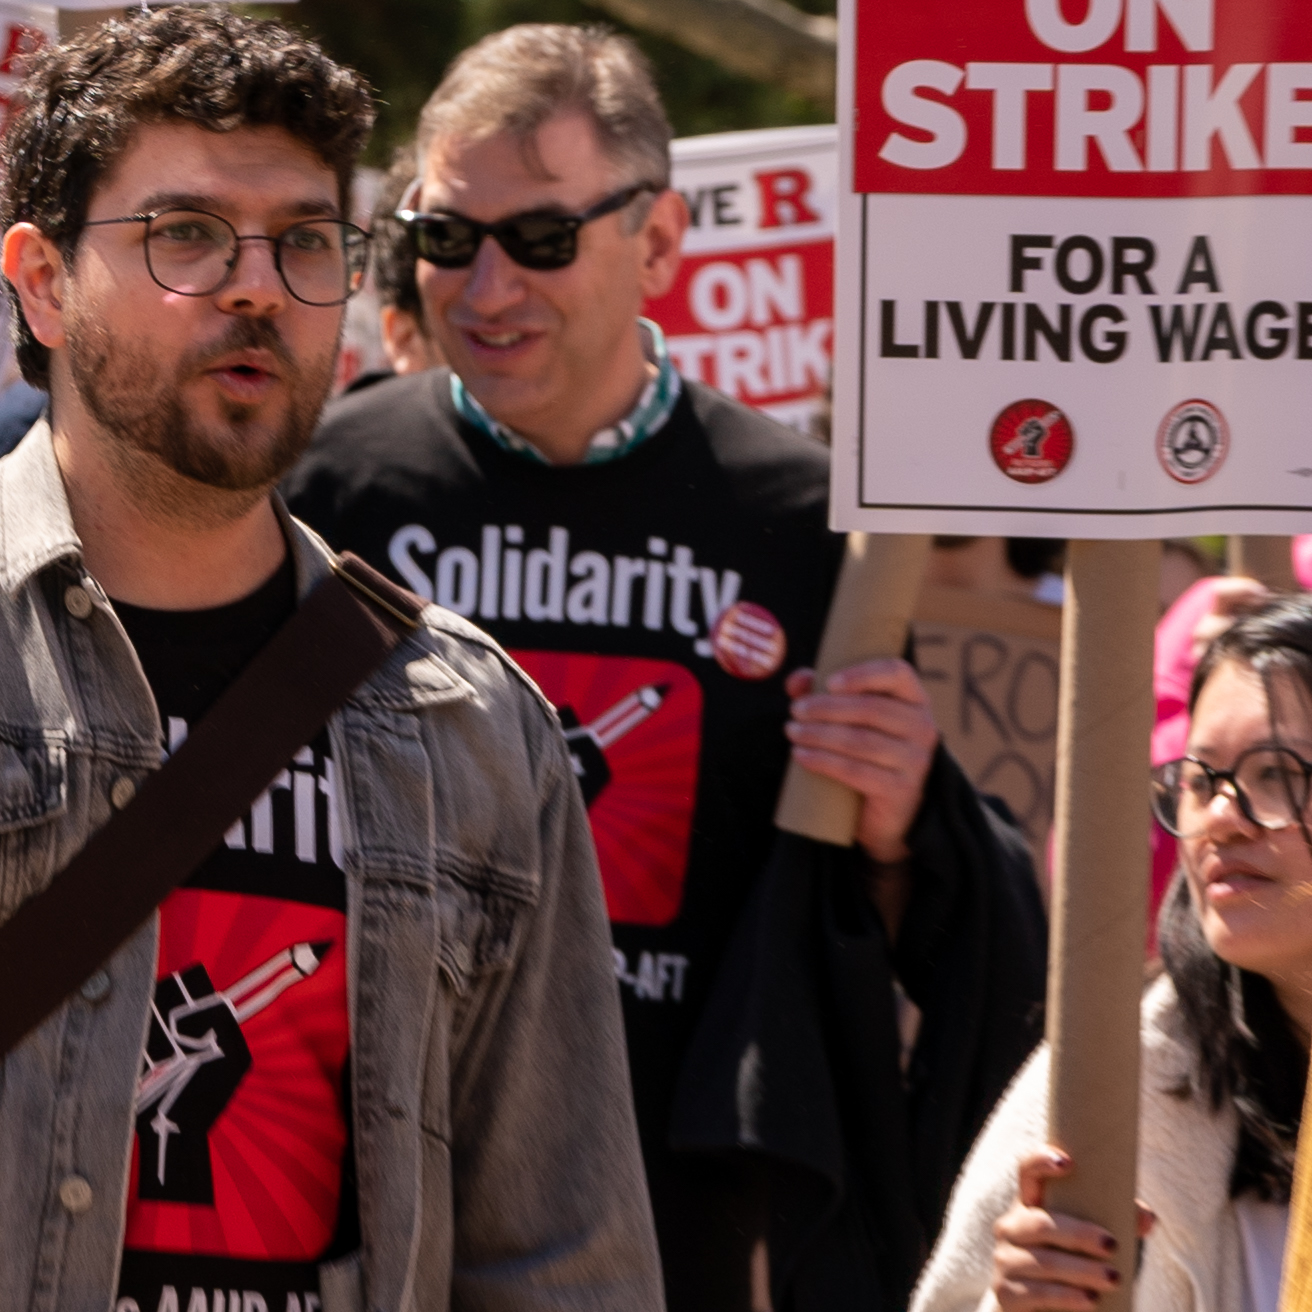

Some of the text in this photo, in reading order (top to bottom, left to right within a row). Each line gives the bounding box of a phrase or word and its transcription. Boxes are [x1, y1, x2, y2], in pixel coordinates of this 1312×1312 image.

[754, 166, 818, 228] R
[688, 255, 803, 330] ON
[1009, 234, 1219, 295] FOR A
[879, 300, 1126, 364] LIVING
[387, 523, 742, 659] Solidarity
